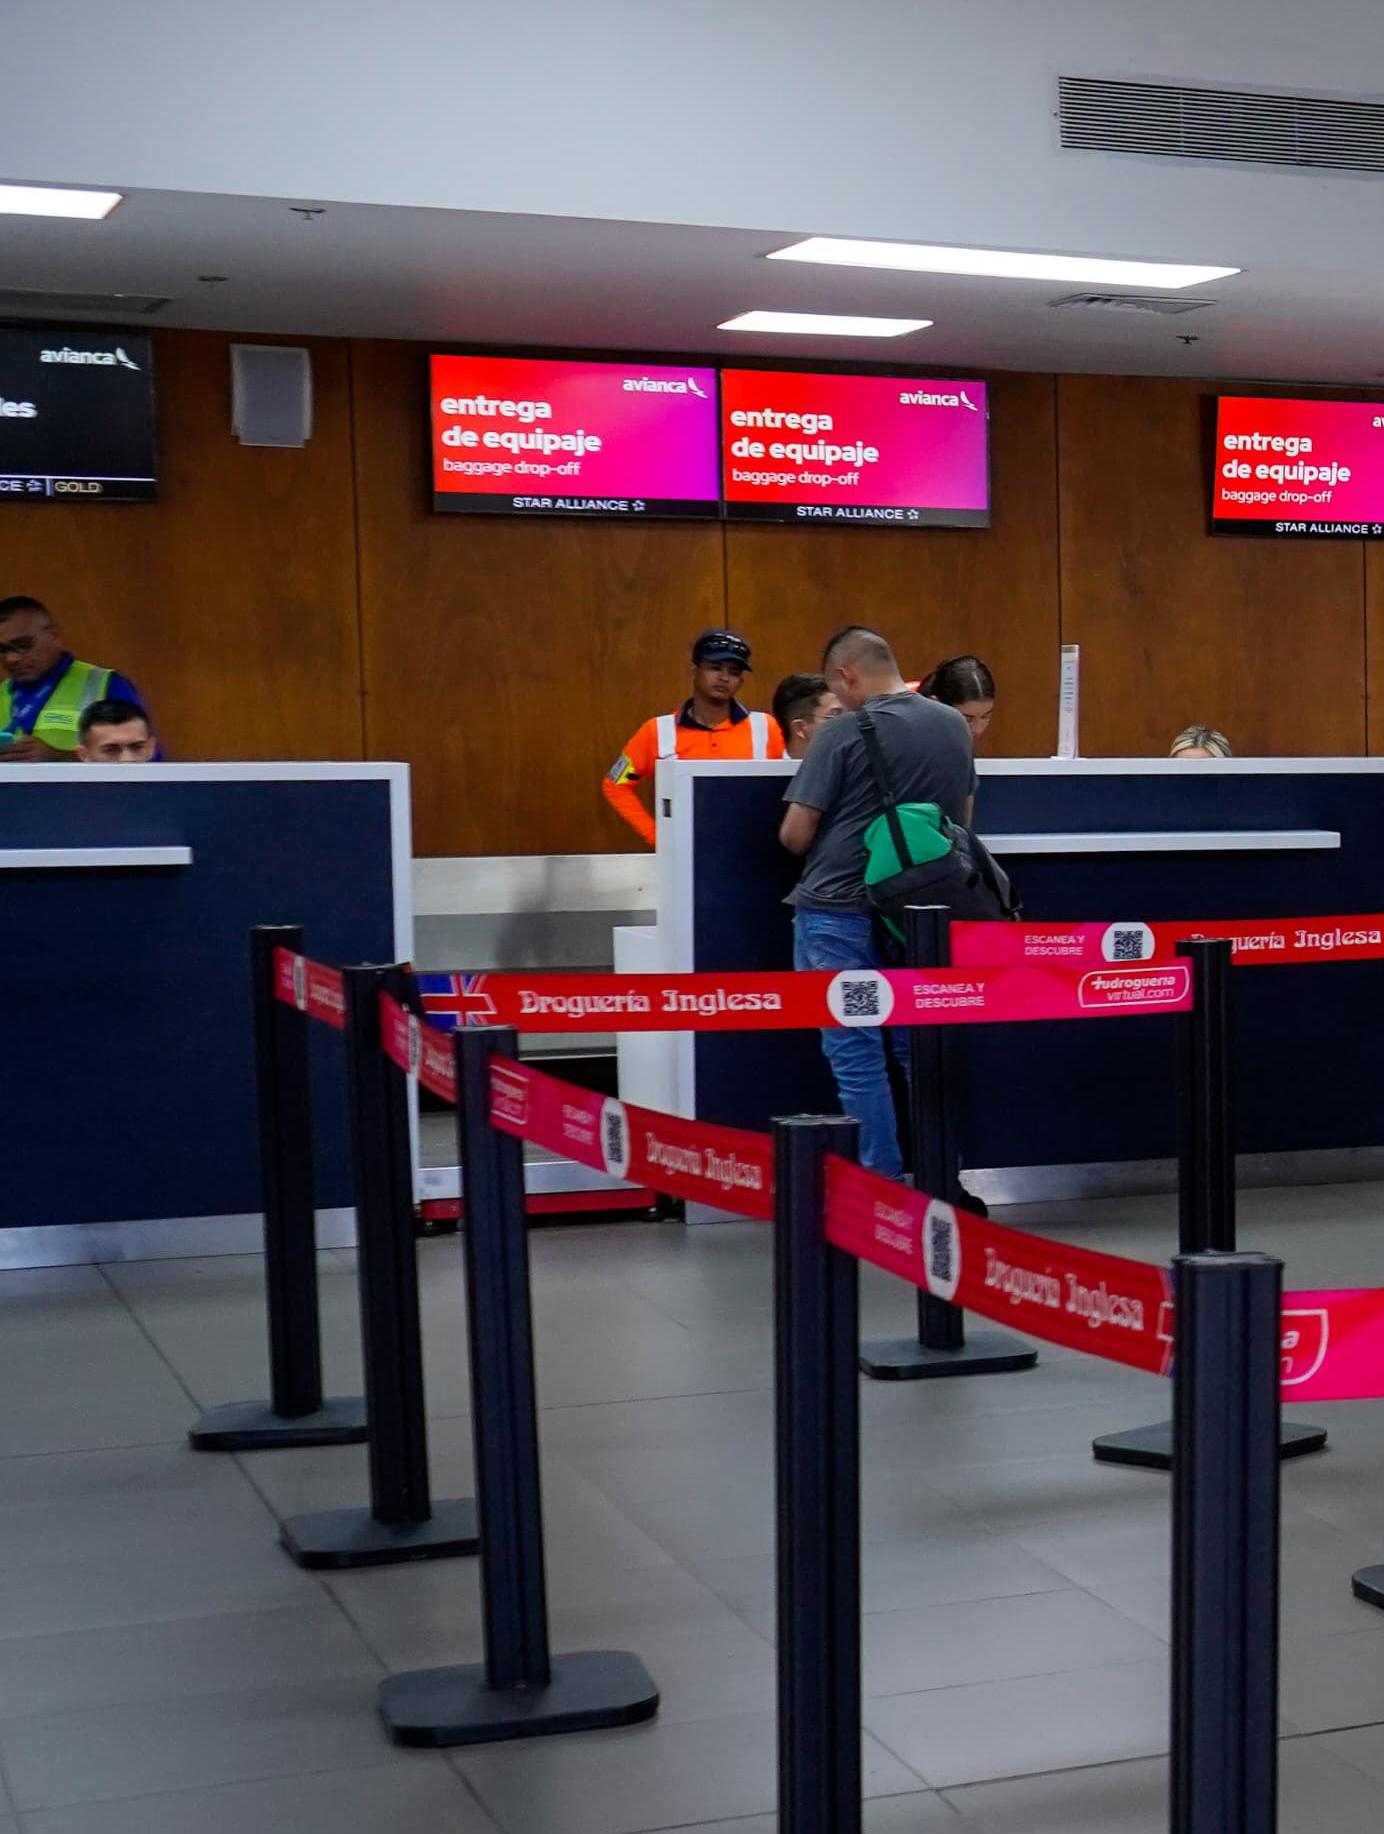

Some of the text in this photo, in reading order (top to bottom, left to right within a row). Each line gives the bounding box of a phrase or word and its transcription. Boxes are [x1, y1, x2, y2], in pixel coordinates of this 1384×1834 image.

[40, 346, 116, 365] avianca
[623, 377, 687, 393] avianca
[900, 391, 958, 406] avianca
[440, 395, 551, 423] entrega
[730, 408, 833, 434] entrega
[442, 425, 601, 456] de equipaje
[1224, 432, 1312, 456] entrega
[731, 437, 879, 467] de equipaje
[443, 458, 580, 477] baggage drop-off
[1222, 459, 1351, 486] de equipaje
[732, 469, 859, 487] baggage drop-off
[55, 481, 102, 493] GOLD
[513, 497, 628, 511] STAR ALLIANCE
[1222, 488, 1332, 505] baggage drop-off
[797, 507, 903, 520] STAR ALLIANCE
[1275, 523, 1368, 534] STAR ALLIANCE
[1024, 935, 1085, 945] ESCANEA Y
[1294, 928, 1382, 950] Inglesa
[1024, 946, 1084, 955] DESCUBRE
[913, 982, 985, 995] ESCANEA Y
[1106, 987, 1175, 1001] virtual.com
[518, 988, 782, 1018] Droguería Inglesa
[915, 995, 985, 1009] DESCUBRE
